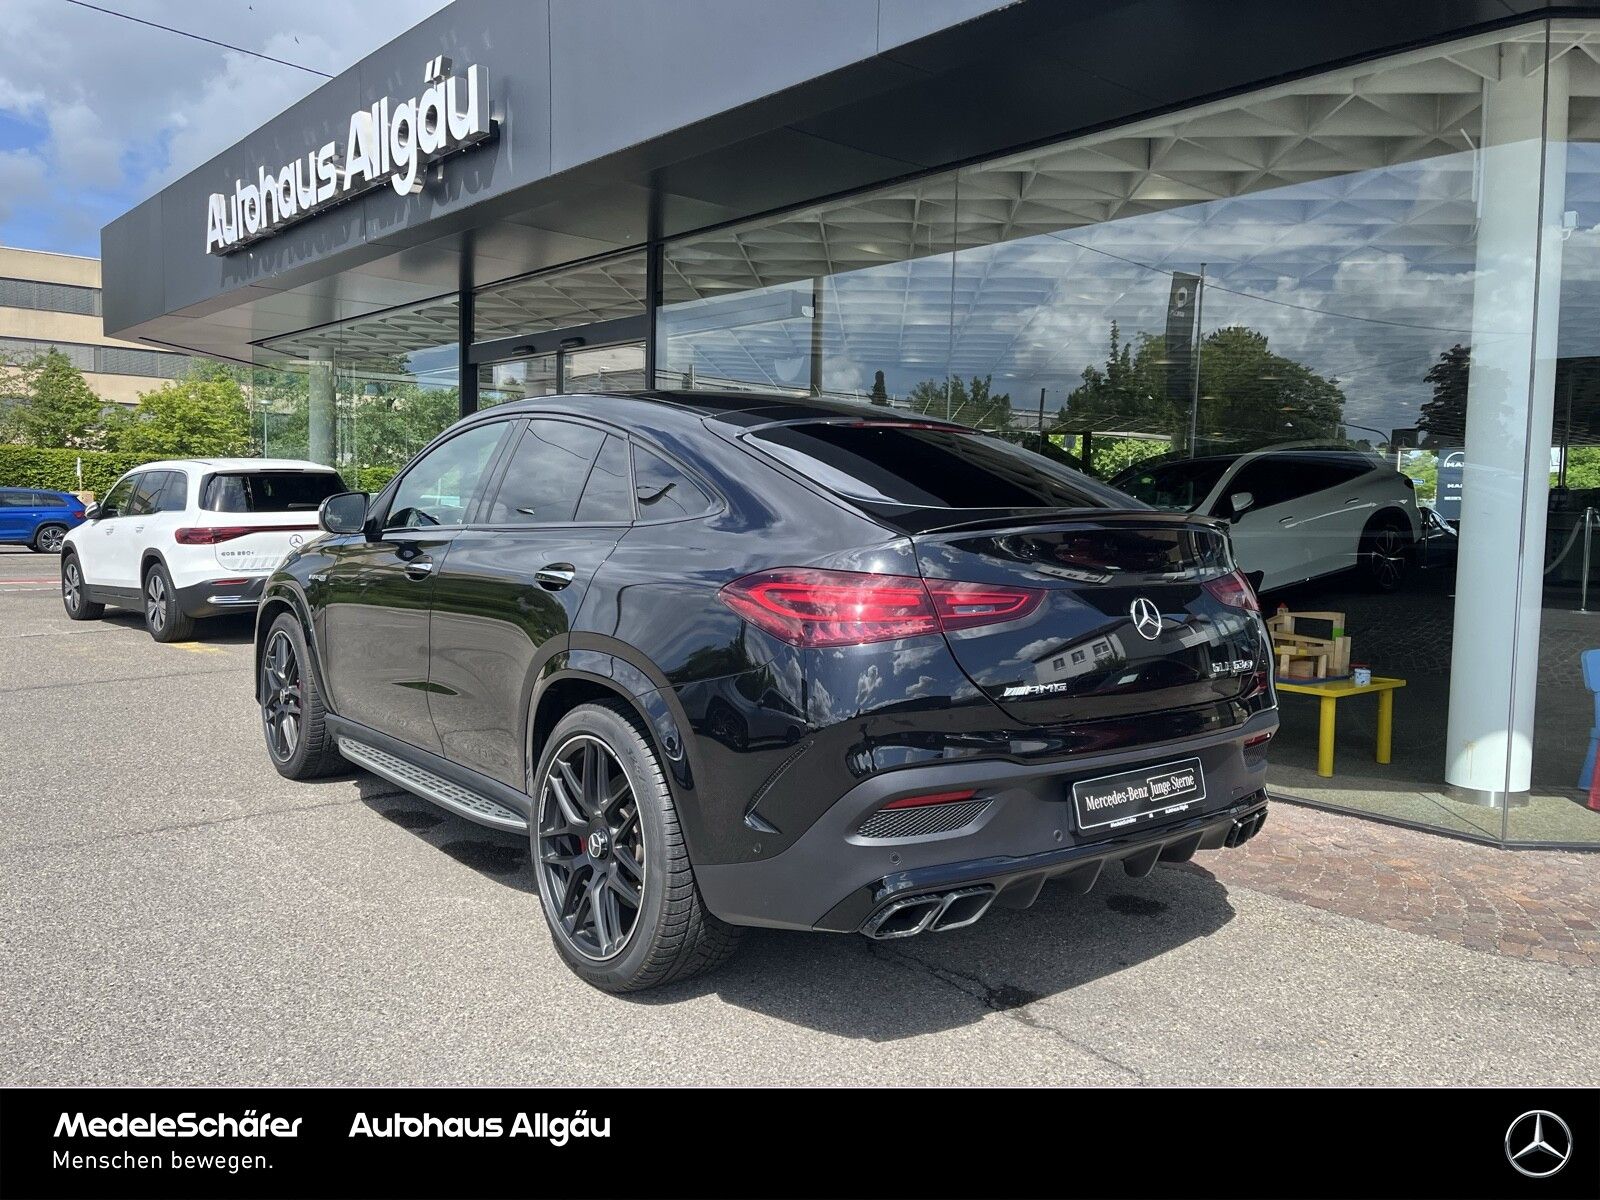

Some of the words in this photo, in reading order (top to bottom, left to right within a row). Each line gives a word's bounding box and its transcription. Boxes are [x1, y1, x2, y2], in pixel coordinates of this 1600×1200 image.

[206, 141, 337, 254] Autohaus
[343, 54, 489, 196] Allgäu
[1085, 786, 1148, 811] Mercedes-Benz
[1149, 782, 1171, 798] Junge
[1170, 775, 1195, 790] Sterne
